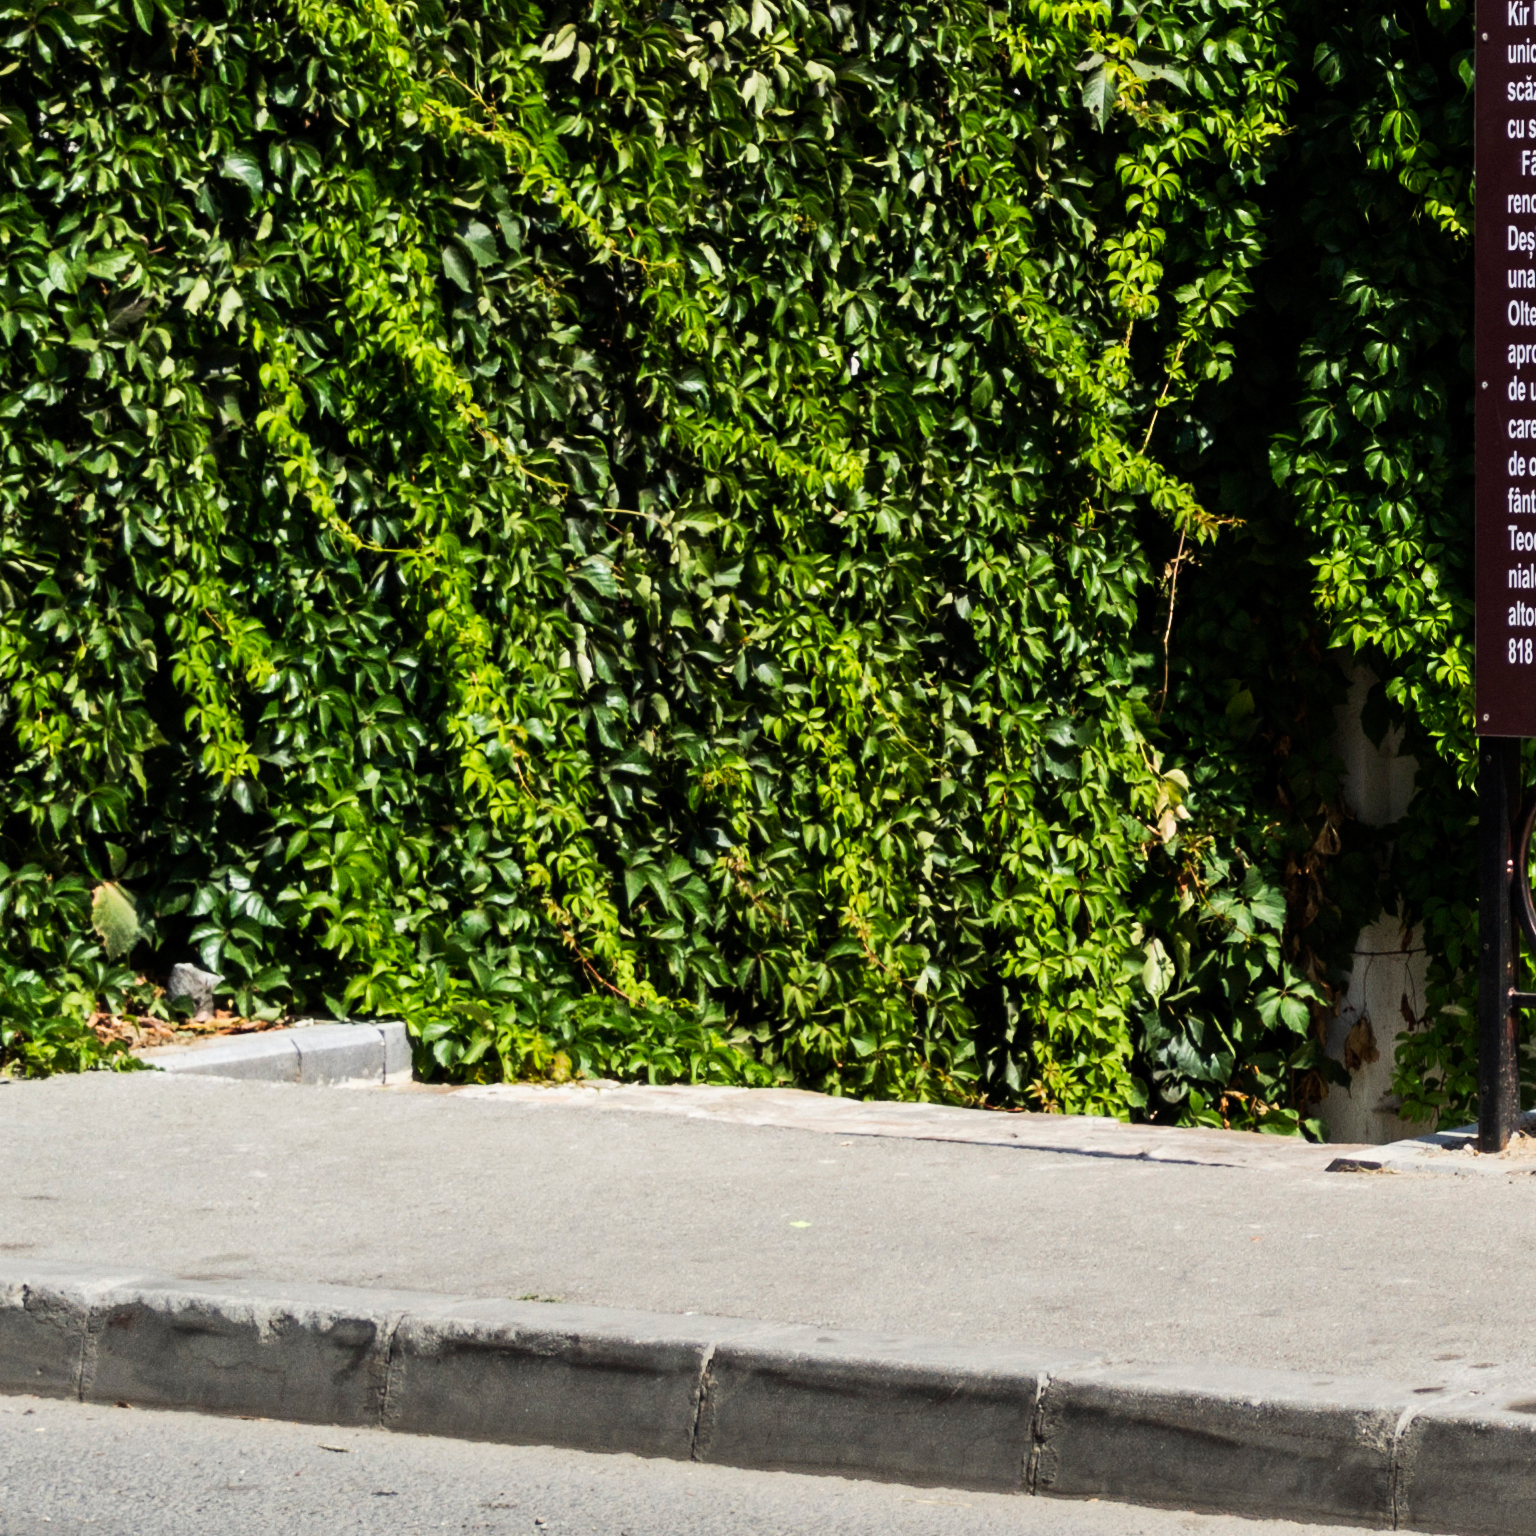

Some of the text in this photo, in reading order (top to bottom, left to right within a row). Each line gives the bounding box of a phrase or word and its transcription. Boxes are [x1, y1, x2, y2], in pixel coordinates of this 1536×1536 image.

[1508, 0, 1530, 26] Kir
[1507, 119, 1524, 139] cu
[1508, 269, 1536, 288] una
[1508, 638, 1533, 664] 818
